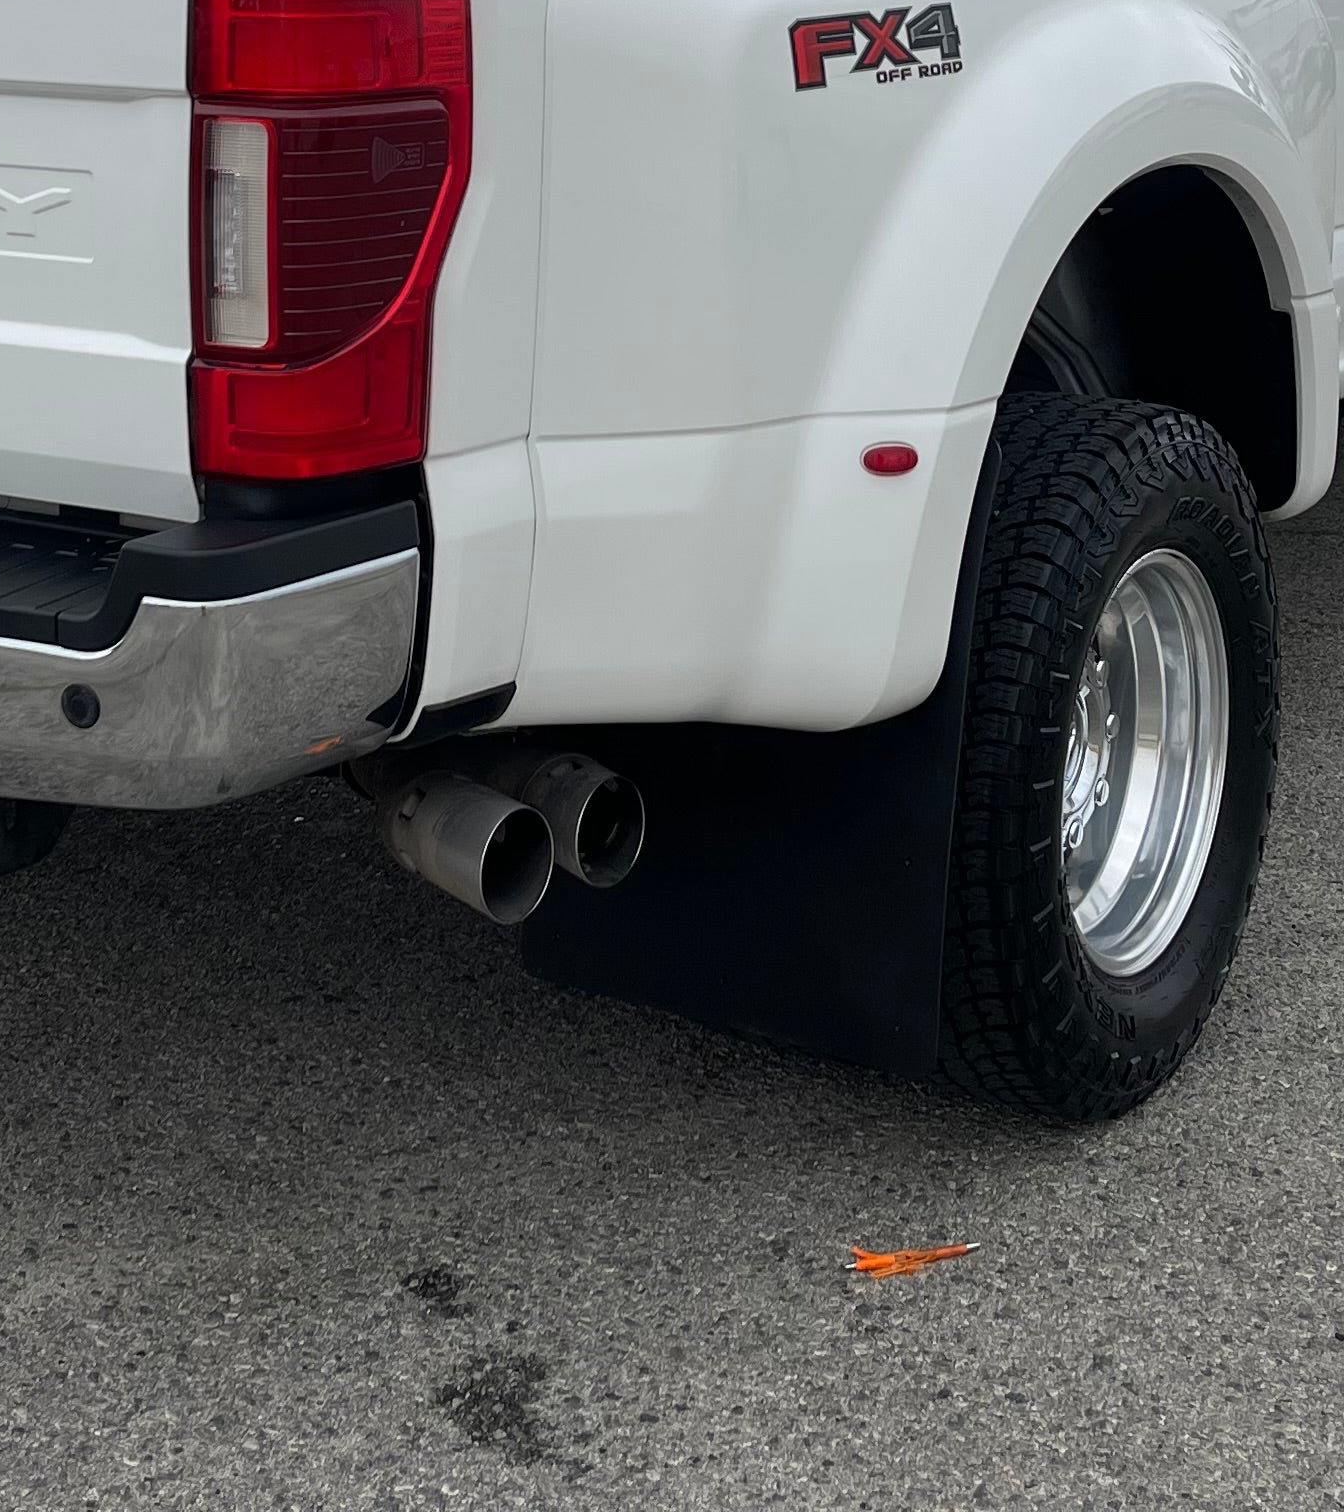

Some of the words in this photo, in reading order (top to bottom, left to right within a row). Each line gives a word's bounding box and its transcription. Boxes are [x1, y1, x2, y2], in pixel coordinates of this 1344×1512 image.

[788, 2, 961, 92] FX4
[876, 68, 912, 84] OFF
[918, 61, 963, 79] ROAD
